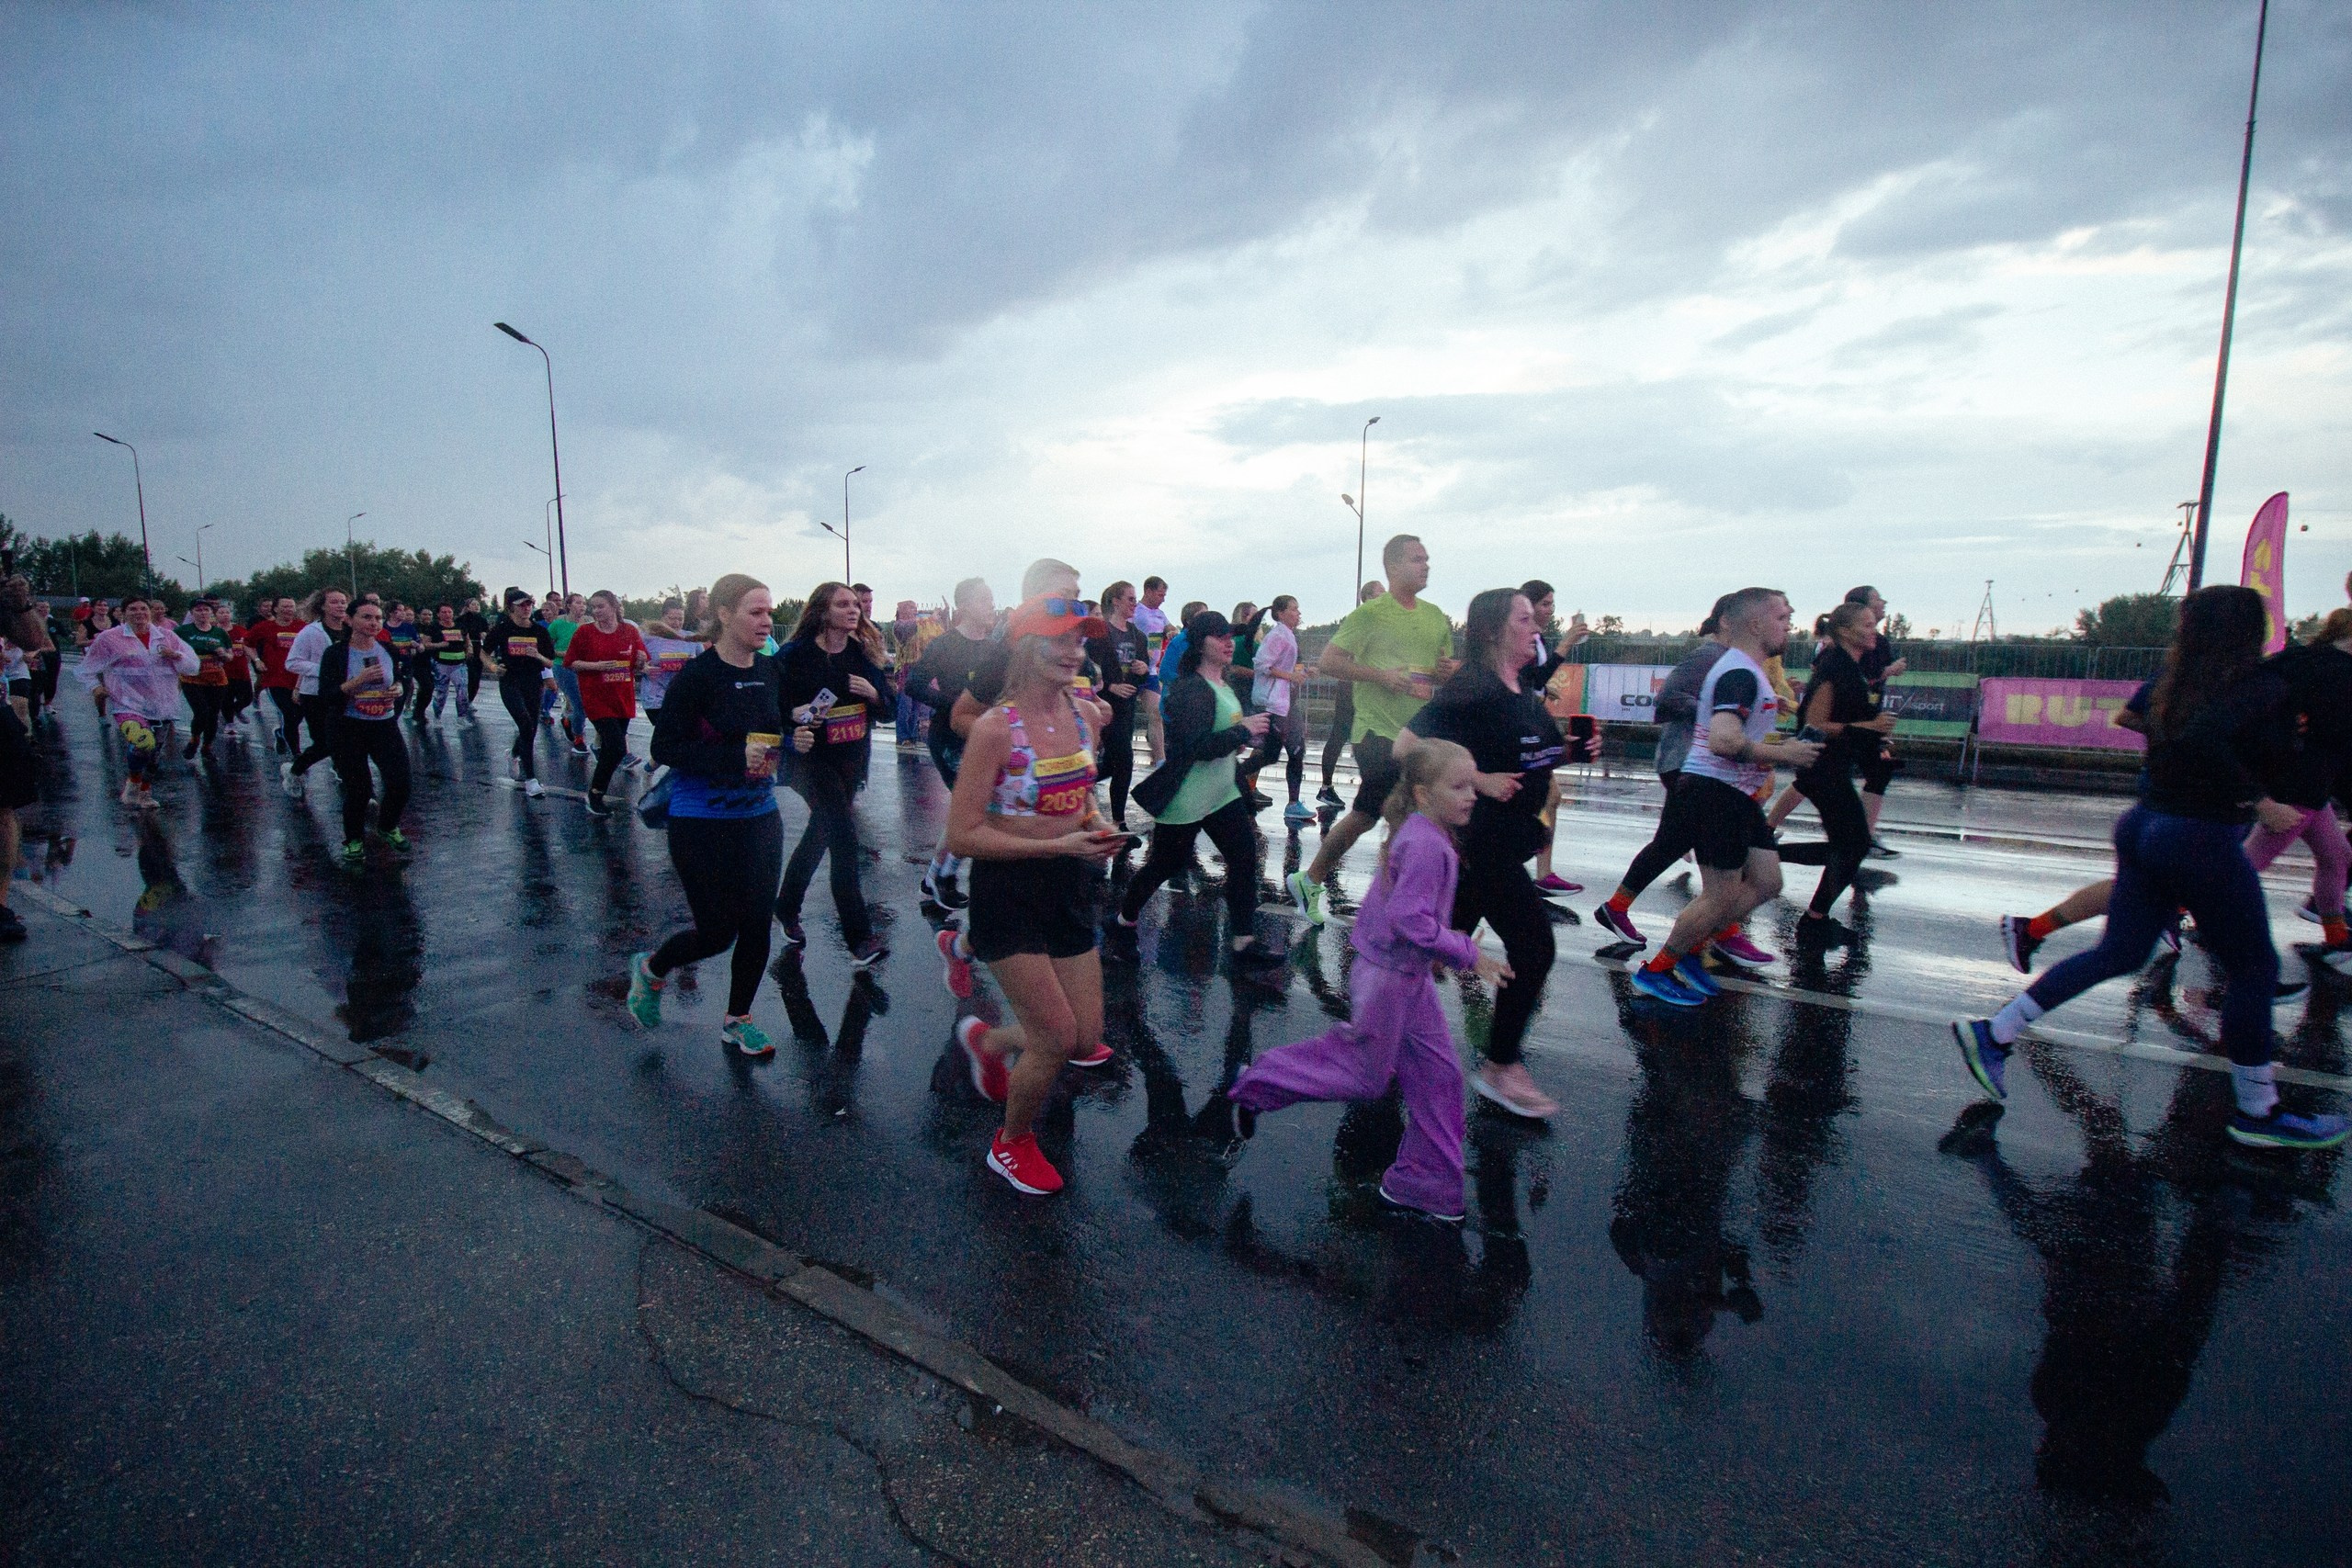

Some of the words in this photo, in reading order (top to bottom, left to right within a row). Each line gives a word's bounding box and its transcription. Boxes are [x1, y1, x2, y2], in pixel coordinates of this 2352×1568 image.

[509, 646, 527, 656] 328
[1620, 694, 1653, 707] CO
[1911, 700, 1945, 713] sport
[2006, 694, 2129, 729] RUT
[831, 724, 862, 741] 2119
